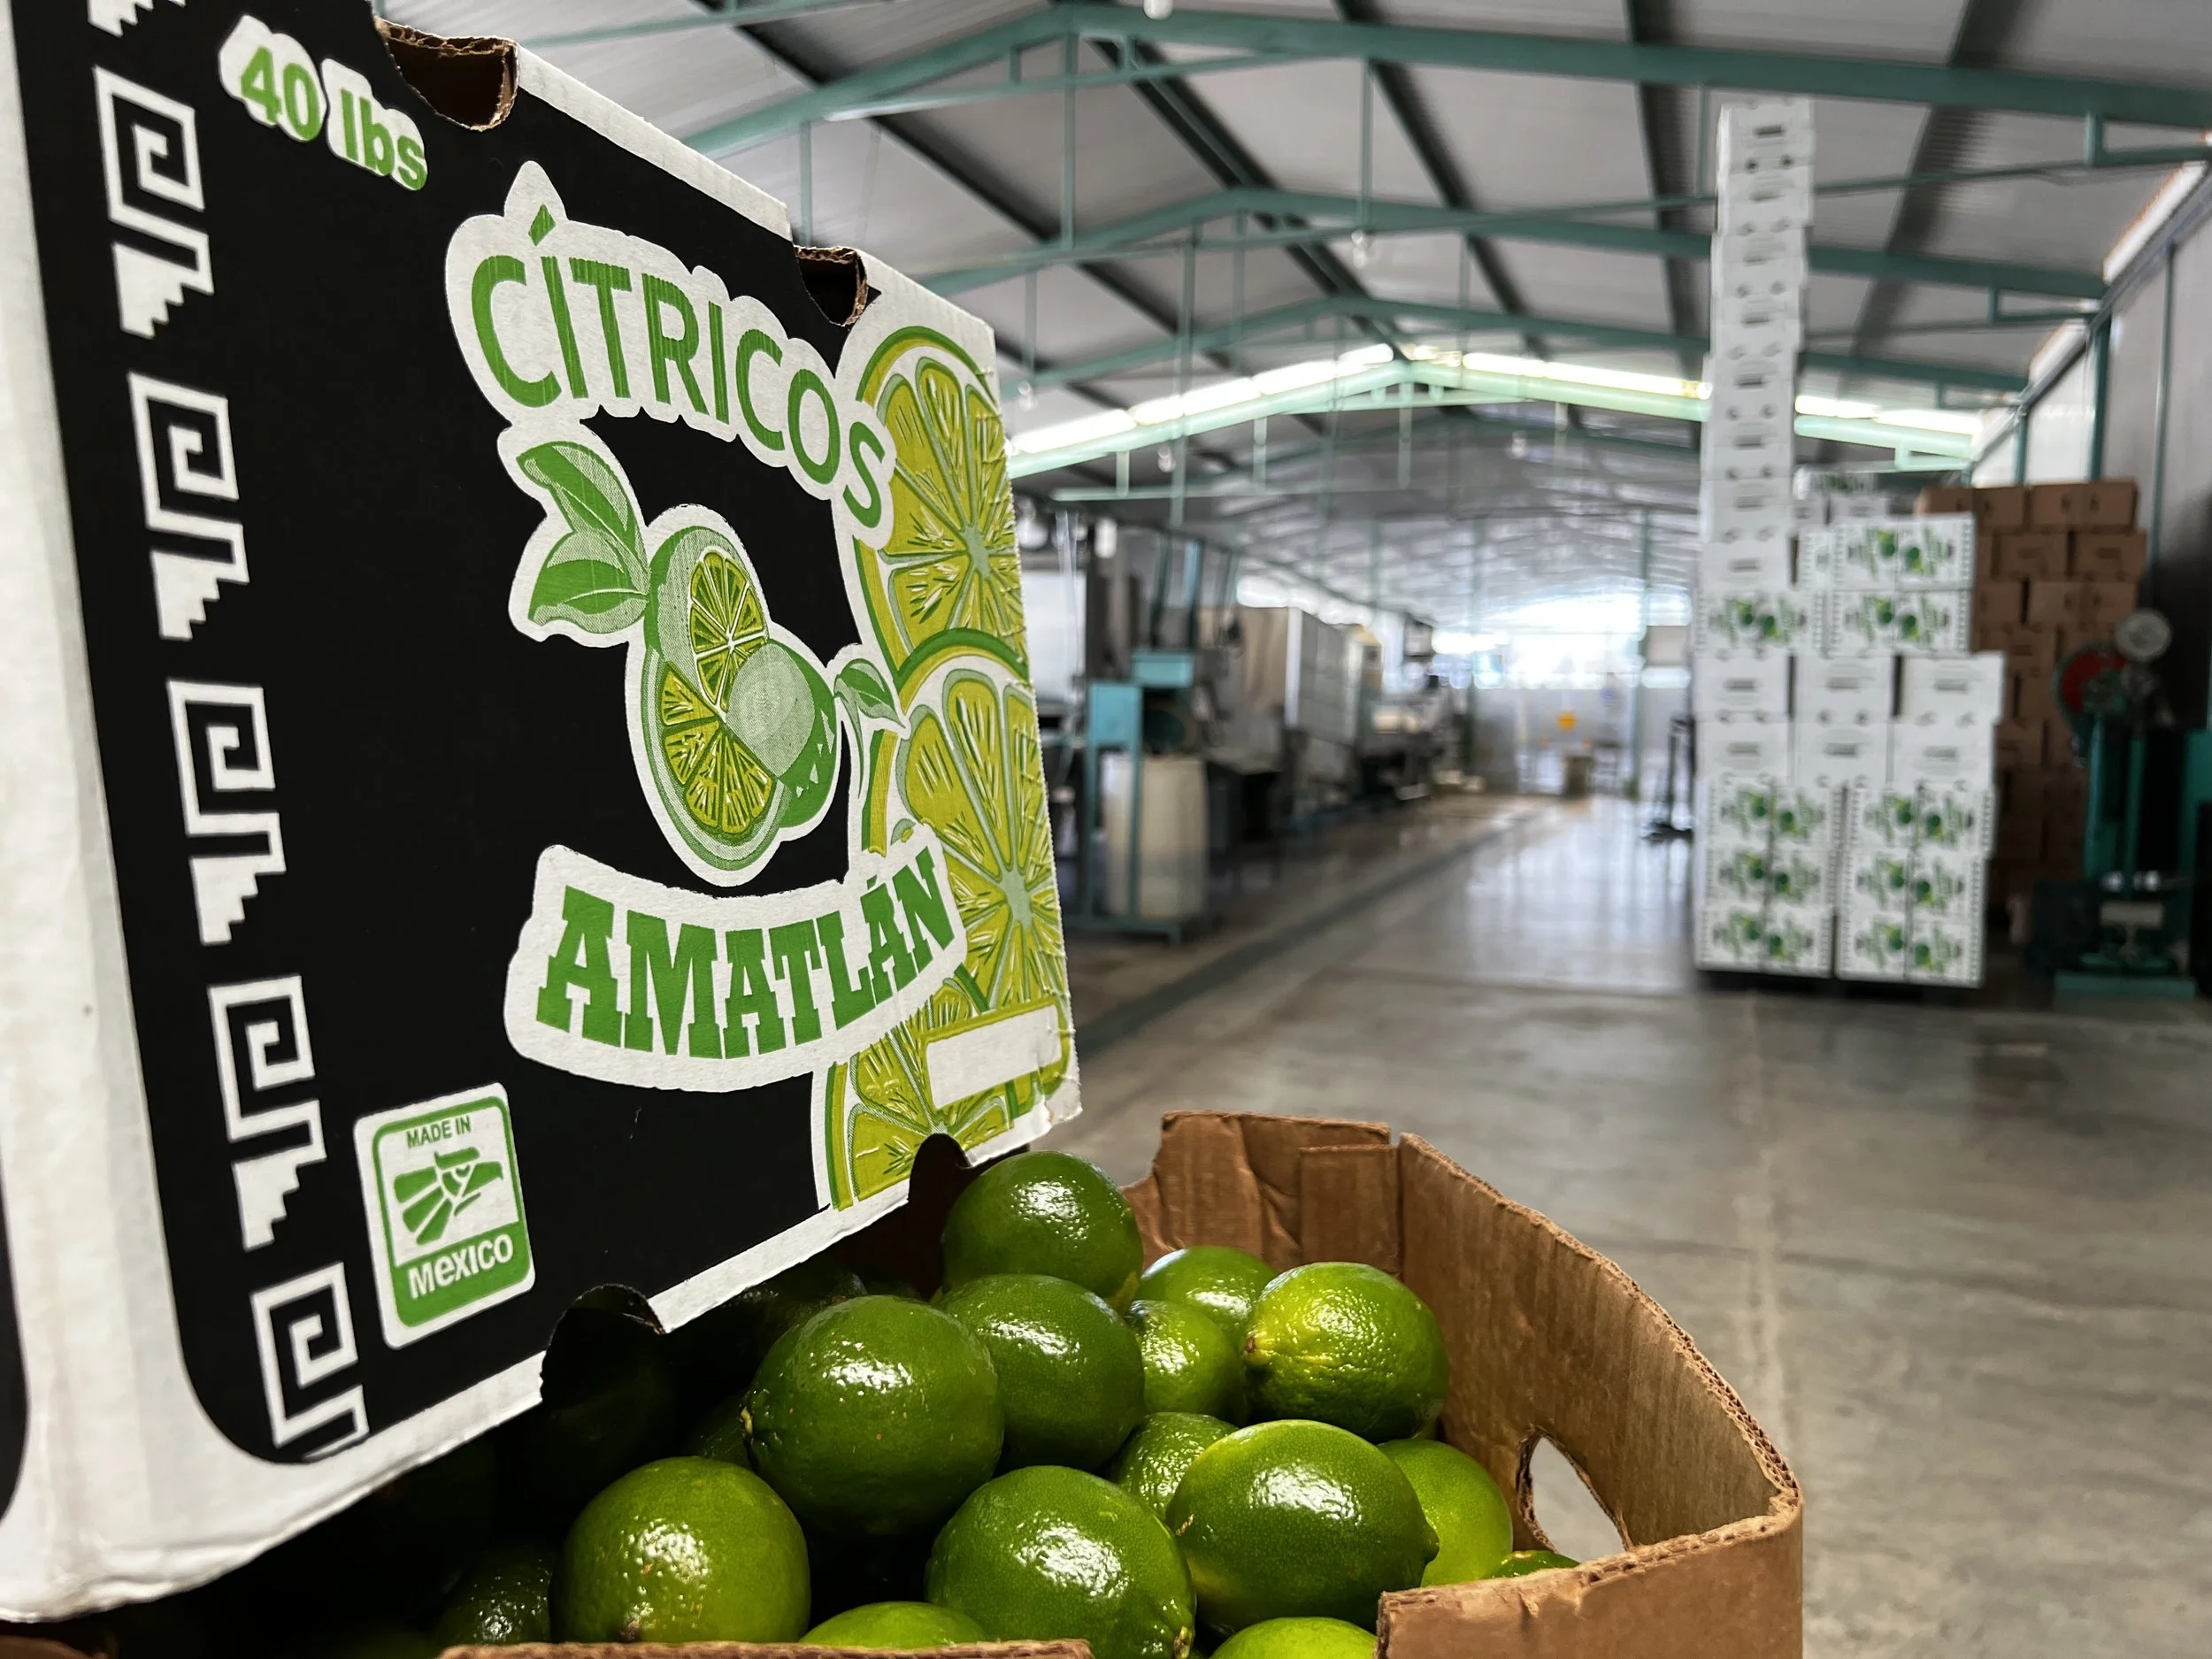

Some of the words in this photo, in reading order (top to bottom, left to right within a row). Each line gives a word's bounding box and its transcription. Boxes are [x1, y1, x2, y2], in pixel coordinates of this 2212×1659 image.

[240, 46, 320, 141] 40
[340, 87, 427, 191] lbs
[471, 204, 886, 529] CÍTRICOS
[535, 848, 956, 1060] AMATLÁN
[406, 1119, 454, 1148] MADE
[456, 1115, 472, 1135] IN
